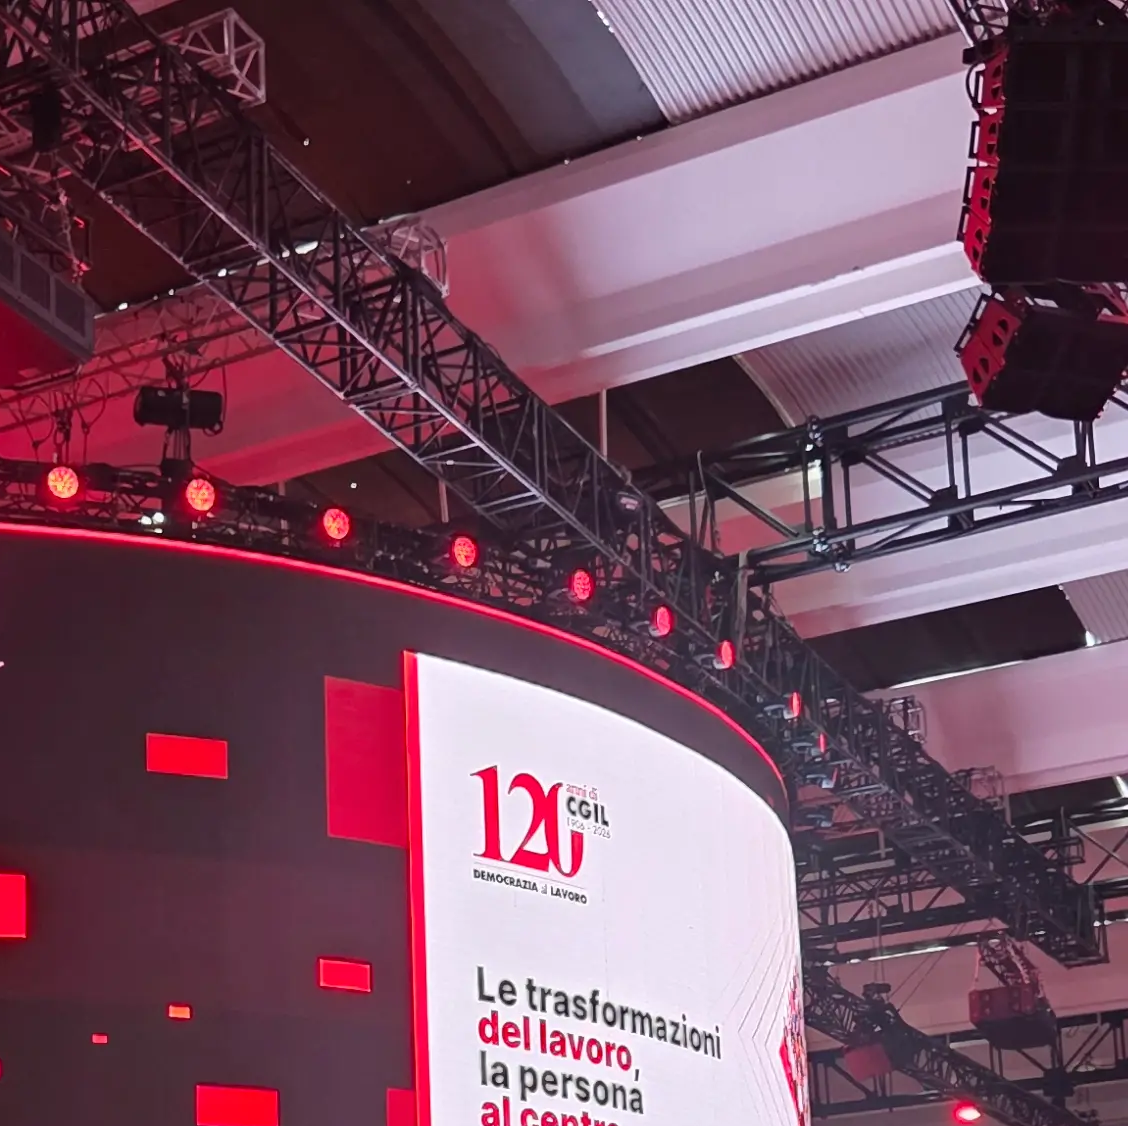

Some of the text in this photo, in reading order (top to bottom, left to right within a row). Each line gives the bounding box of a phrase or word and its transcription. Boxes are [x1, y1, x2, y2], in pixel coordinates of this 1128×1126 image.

[470, 765, 584, 877] 120
[566, 796, 610, 828] CGIL
[473, 869, 539, 893] DEMOCRAZIA
[551, 886, 587, 905] LAVORO
[477, 966, 722, 1060] Le trasformazioni
[478, 1010, 640, 1082] del lavoro,
[480, 1050, 644, 1115] la persona
